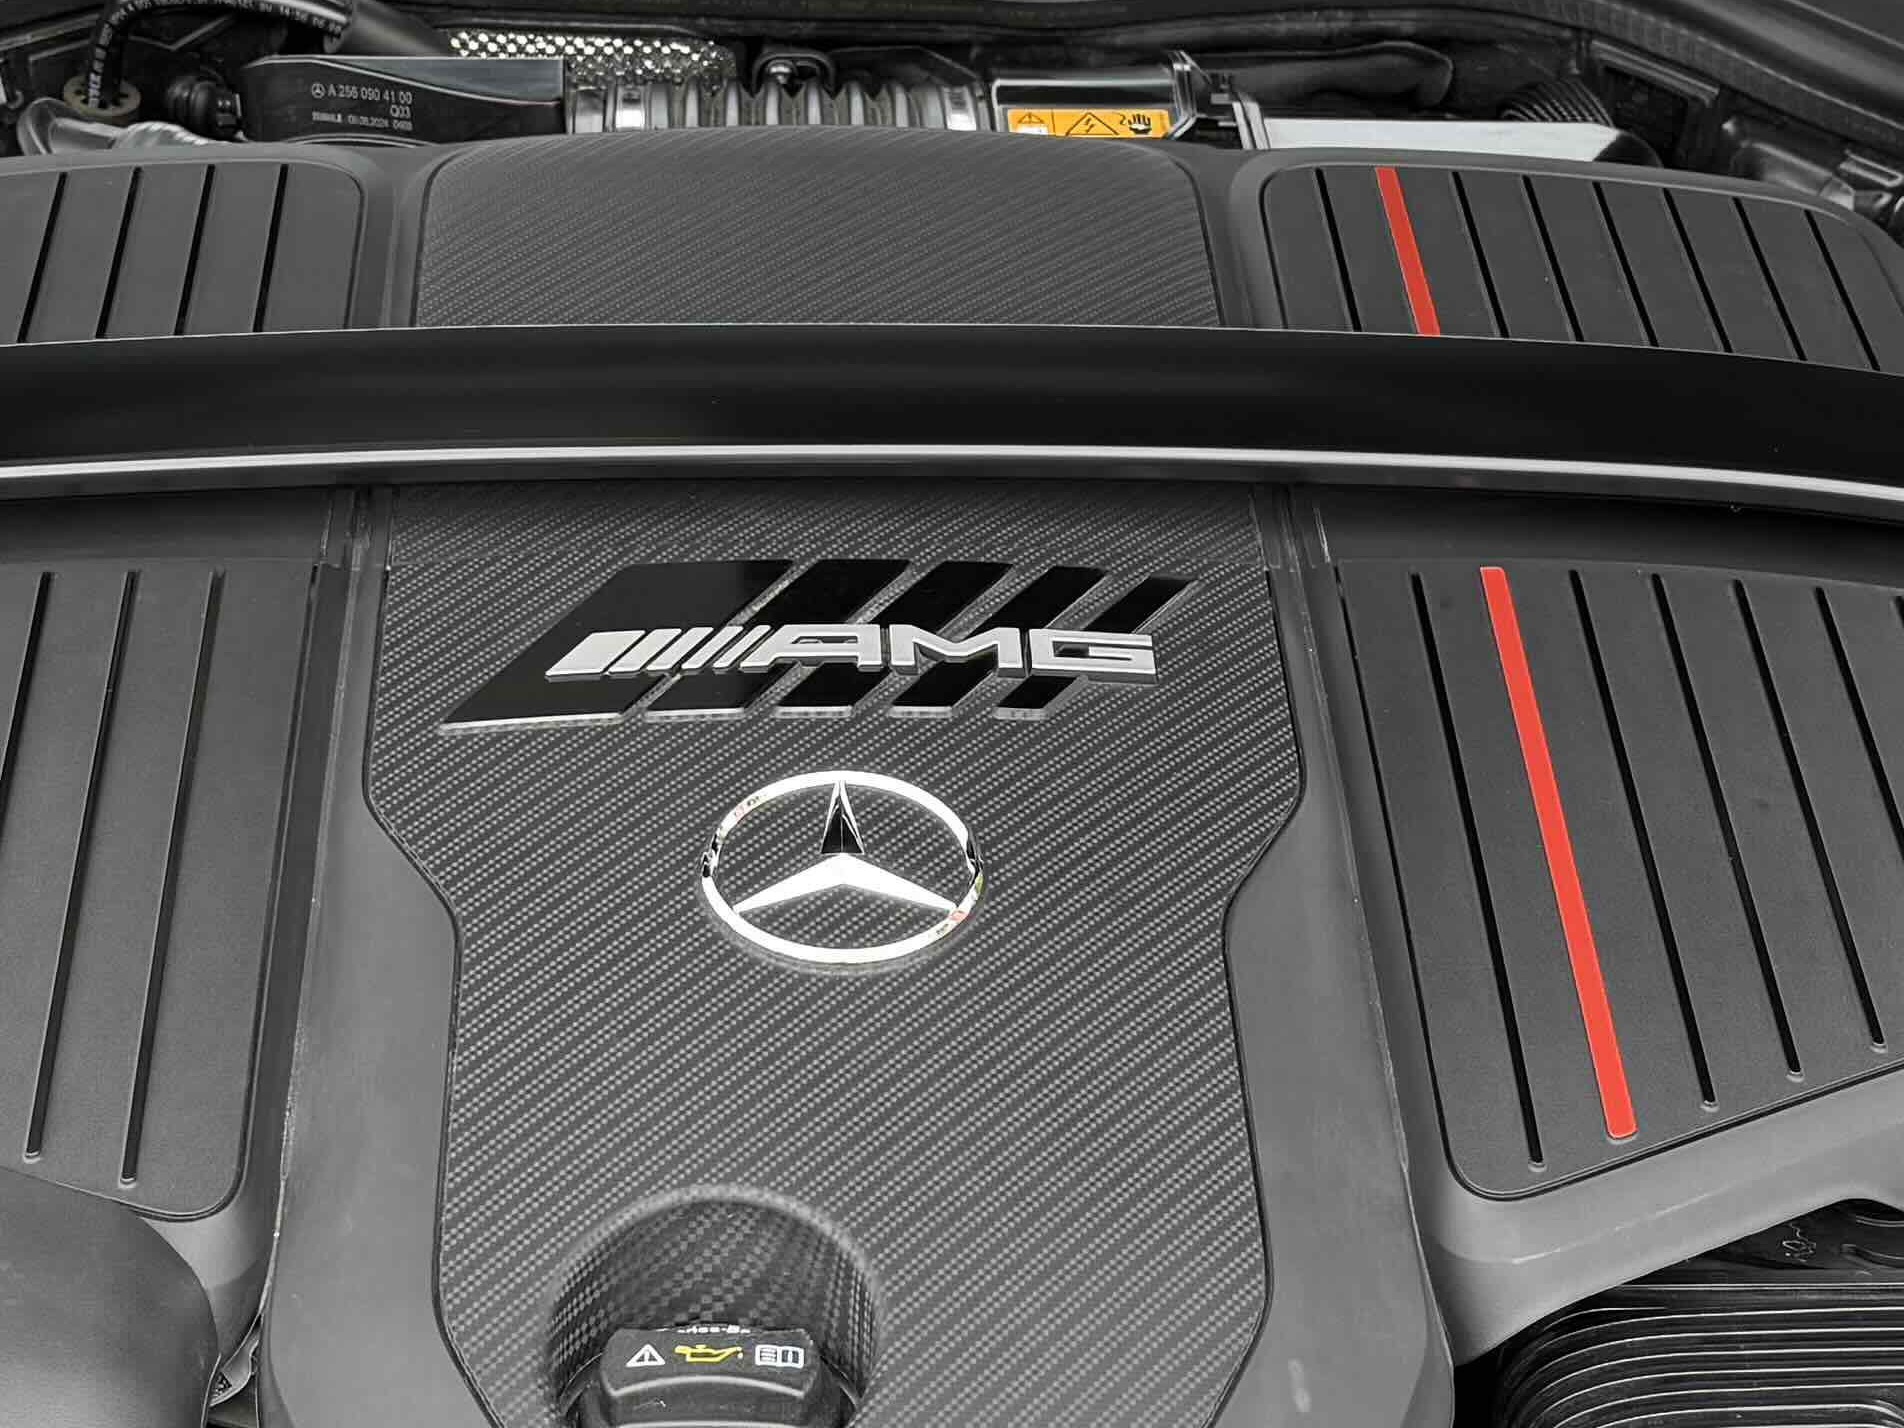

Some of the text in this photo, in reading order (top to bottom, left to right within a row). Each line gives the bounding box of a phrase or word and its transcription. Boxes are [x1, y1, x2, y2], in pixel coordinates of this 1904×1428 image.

[327, 83, 337, 97] A
[360, 87, 381, 101] 090
[383, 89, 396, 103] 41
[398, 91, 413, 105] 00
[738, 623, 1157, 682] AMG
